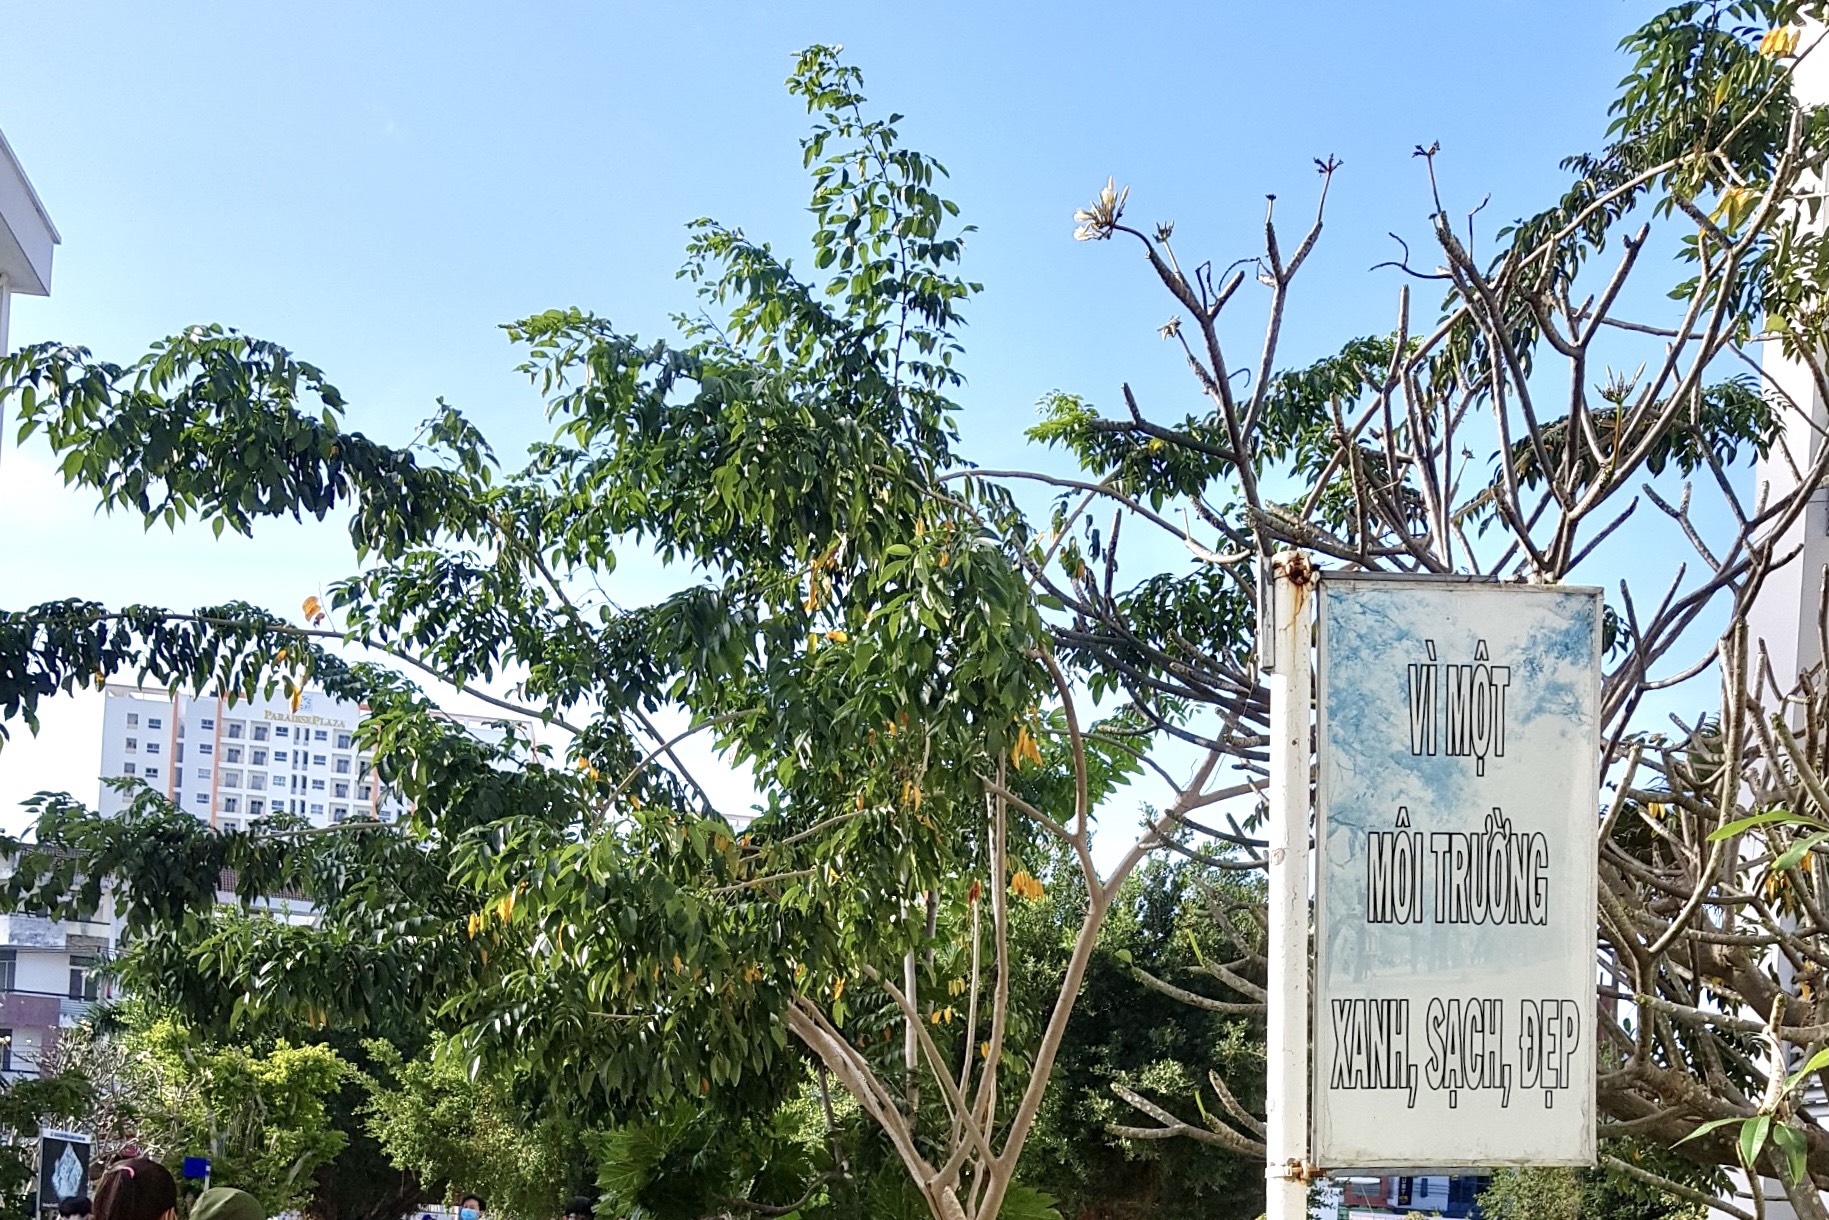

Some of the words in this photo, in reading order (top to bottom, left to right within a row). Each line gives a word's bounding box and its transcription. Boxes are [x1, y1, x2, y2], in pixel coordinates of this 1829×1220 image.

[1408, 639, 1438, 757] VÌ
[1446, 639, 1511, 777] MỘT
[1367, 806, 1424, 924] MÔI
[1430, 807, 1549, 926] TRƯỜNG
[1330, 998, 1418, 1108] XANH,
[1425, 997, 1512, 1108] SẠCH,
[1519, 999, 1581, 1109] ĐẸP
